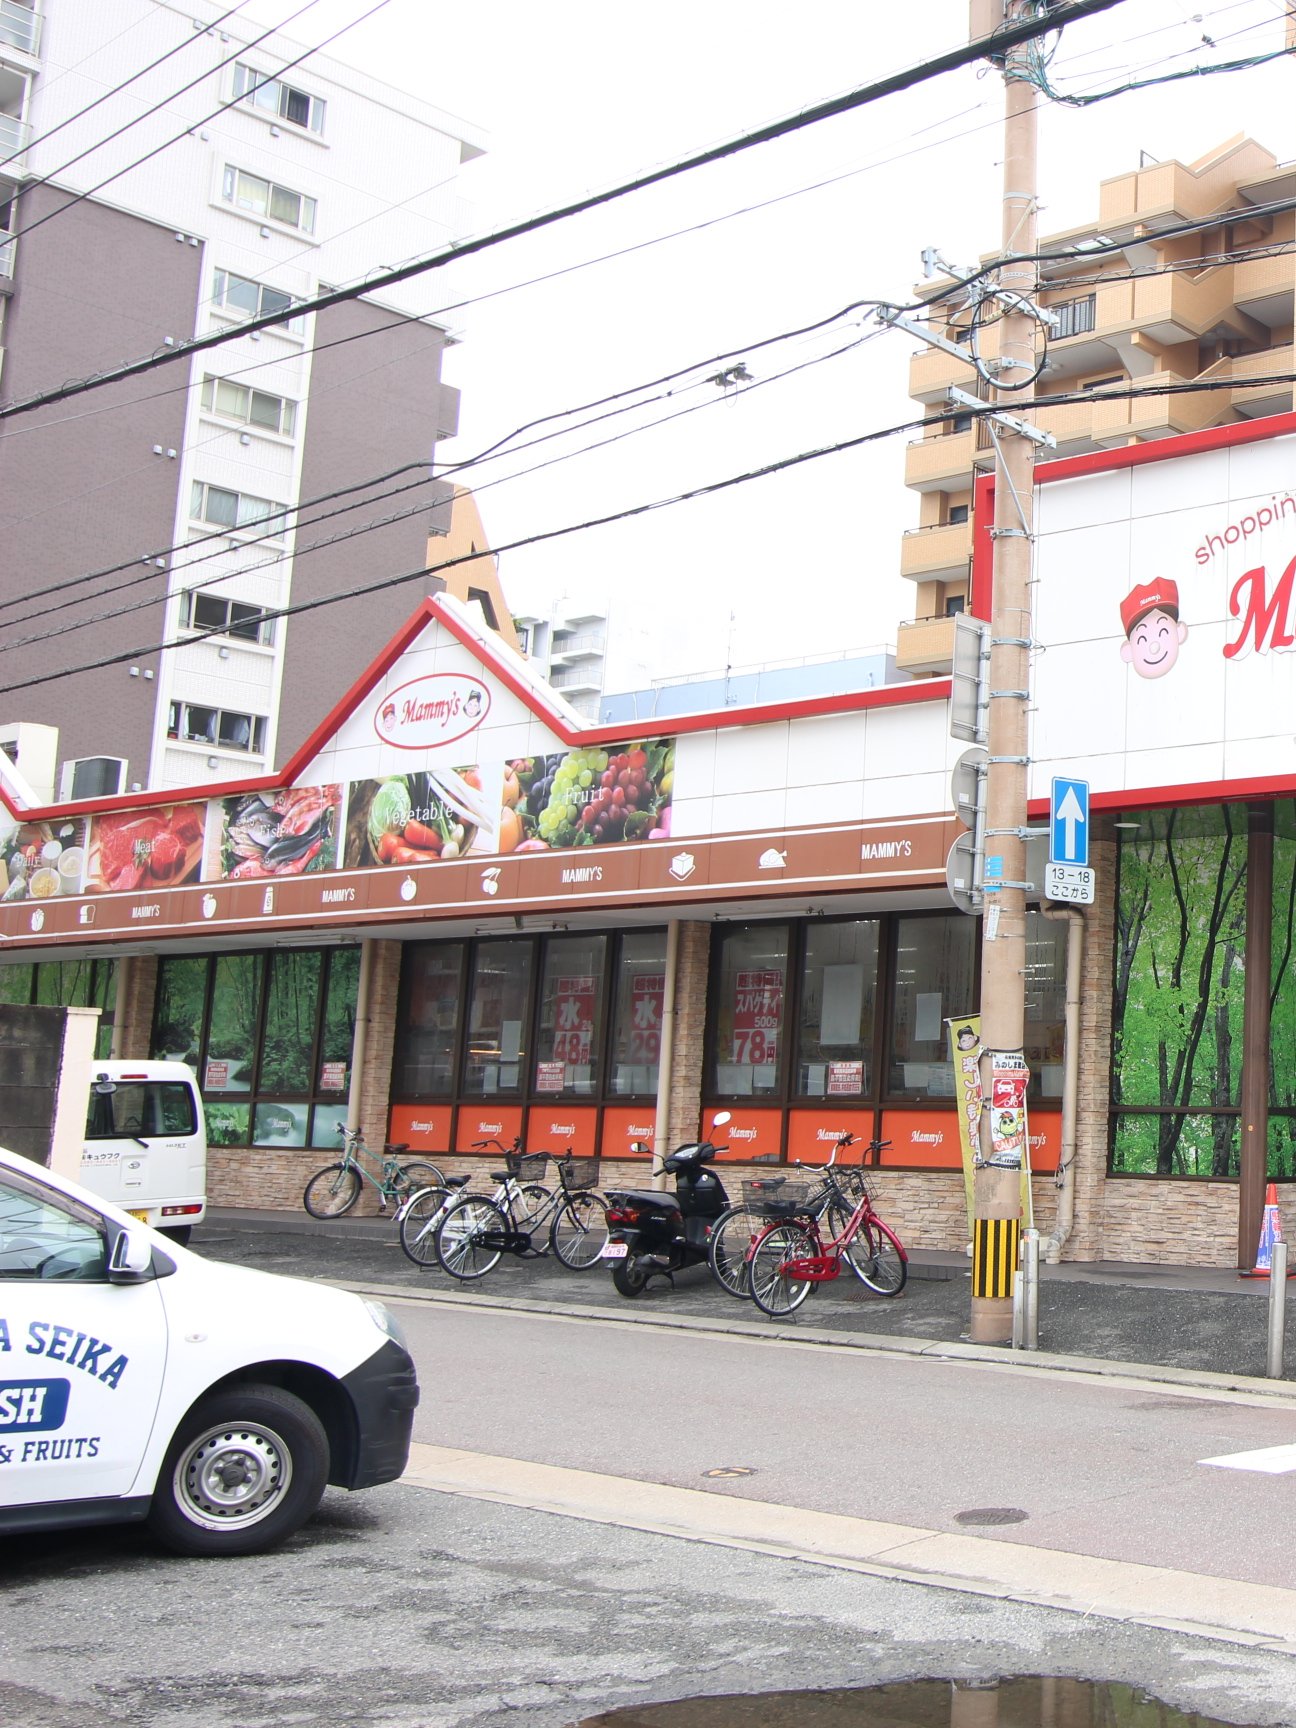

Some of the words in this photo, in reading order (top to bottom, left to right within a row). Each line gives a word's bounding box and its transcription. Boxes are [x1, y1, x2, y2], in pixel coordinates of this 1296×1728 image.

[401, 691, 460, 727] Mammy's
[566, 785, 605, 805] Fruit
[134, 838, 156, 853] Meat
[861, 840, 912, 859] MAMMY'S
[562, 866, 603, 883] MAMMY'S
[322, 888, 355, 903] MAMMY'S
[1051, 885, 1089, 900] ここから
[132, 905, 160, 918] MAMMY'S
[560, 996, 581, 1029] 水
[634, 994, 656, 1028] 水
[754, 1016, 777, 1028] 500g
[478, 1121, 503, 1136] Mammy's
[550, 1122, 575, 1138] Mammy's
[728, 1126, 757, 1142] Mammy's
[910, 1129, 943, 1147] Mammy's
[26, 1321, 129, 1390] SEIKA
[21, 1437, 101, 1462] FRUITS
